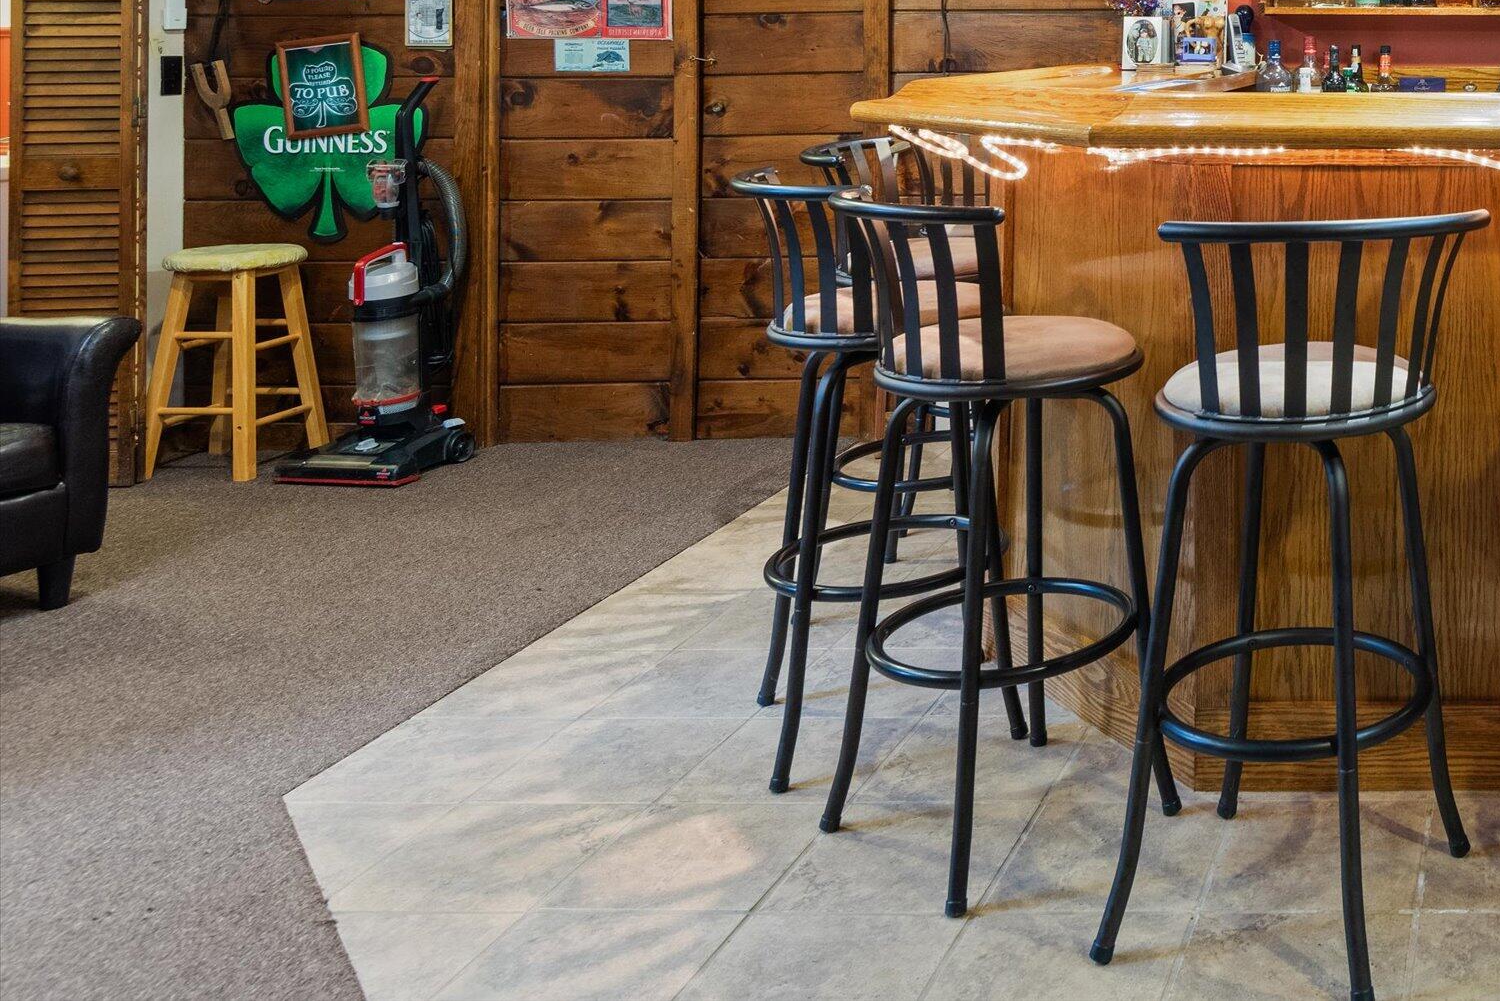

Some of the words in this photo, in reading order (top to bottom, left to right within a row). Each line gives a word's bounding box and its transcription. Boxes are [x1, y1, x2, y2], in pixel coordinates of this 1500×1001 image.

[522, 23, 535, 32] DEER
[311, 65, 334, 74] FOUND
[295, 87, 314, 99] TO
[316, 84, 349, 99] PUB
[263, 125, 388, 154] GUINNESS
